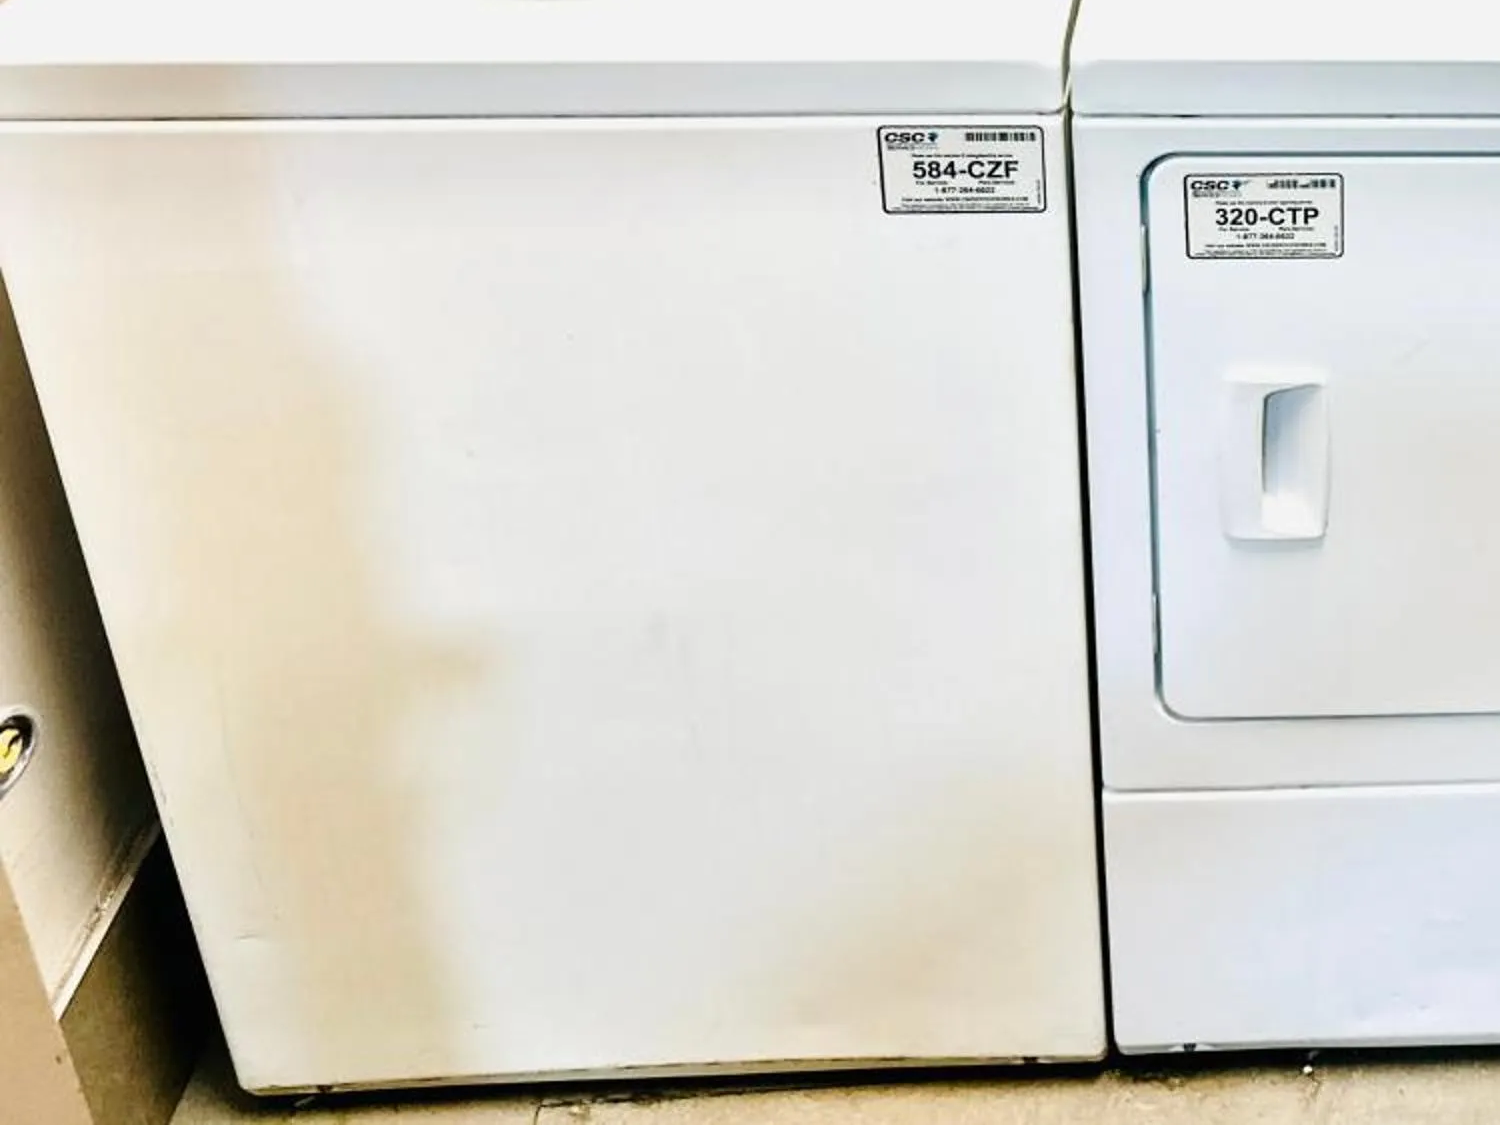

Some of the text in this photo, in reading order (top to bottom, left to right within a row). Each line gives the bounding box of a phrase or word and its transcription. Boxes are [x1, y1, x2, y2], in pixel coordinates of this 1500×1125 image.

[884, 132, 926, 144] CSC
[912, 160, 1020, 180] 584-CZF
[1190, 180, 1230, 191] CSC
[1215, 207, 1320, 226] 320-CTP
